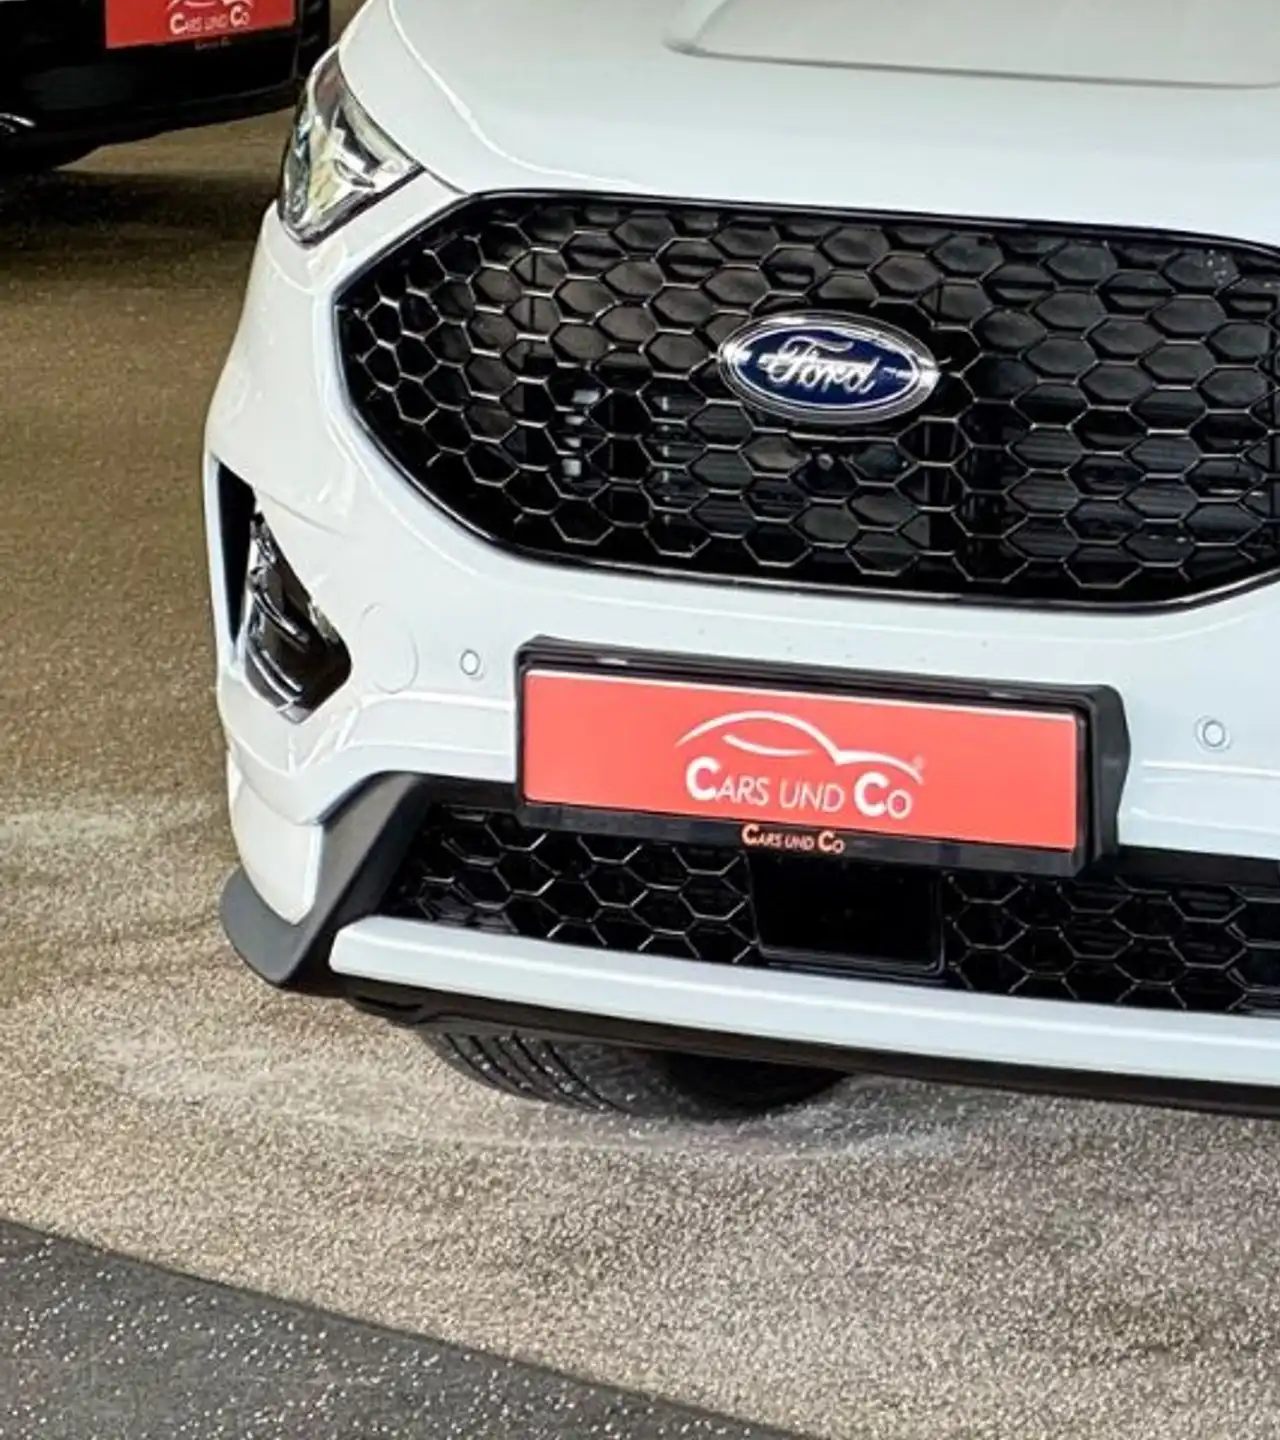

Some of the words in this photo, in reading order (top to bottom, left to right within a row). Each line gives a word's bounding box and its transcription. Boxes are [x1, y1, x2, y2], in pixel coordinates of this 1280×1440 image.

[757, 335, 881, 395] Ford
[685, 755, 770, 807] CARS
[778, 777, 846, 813] UND
[853, 771, 914, 820] CO
[741, 823, 783, 848] CARS
[817, 829, 847, 854] CO
